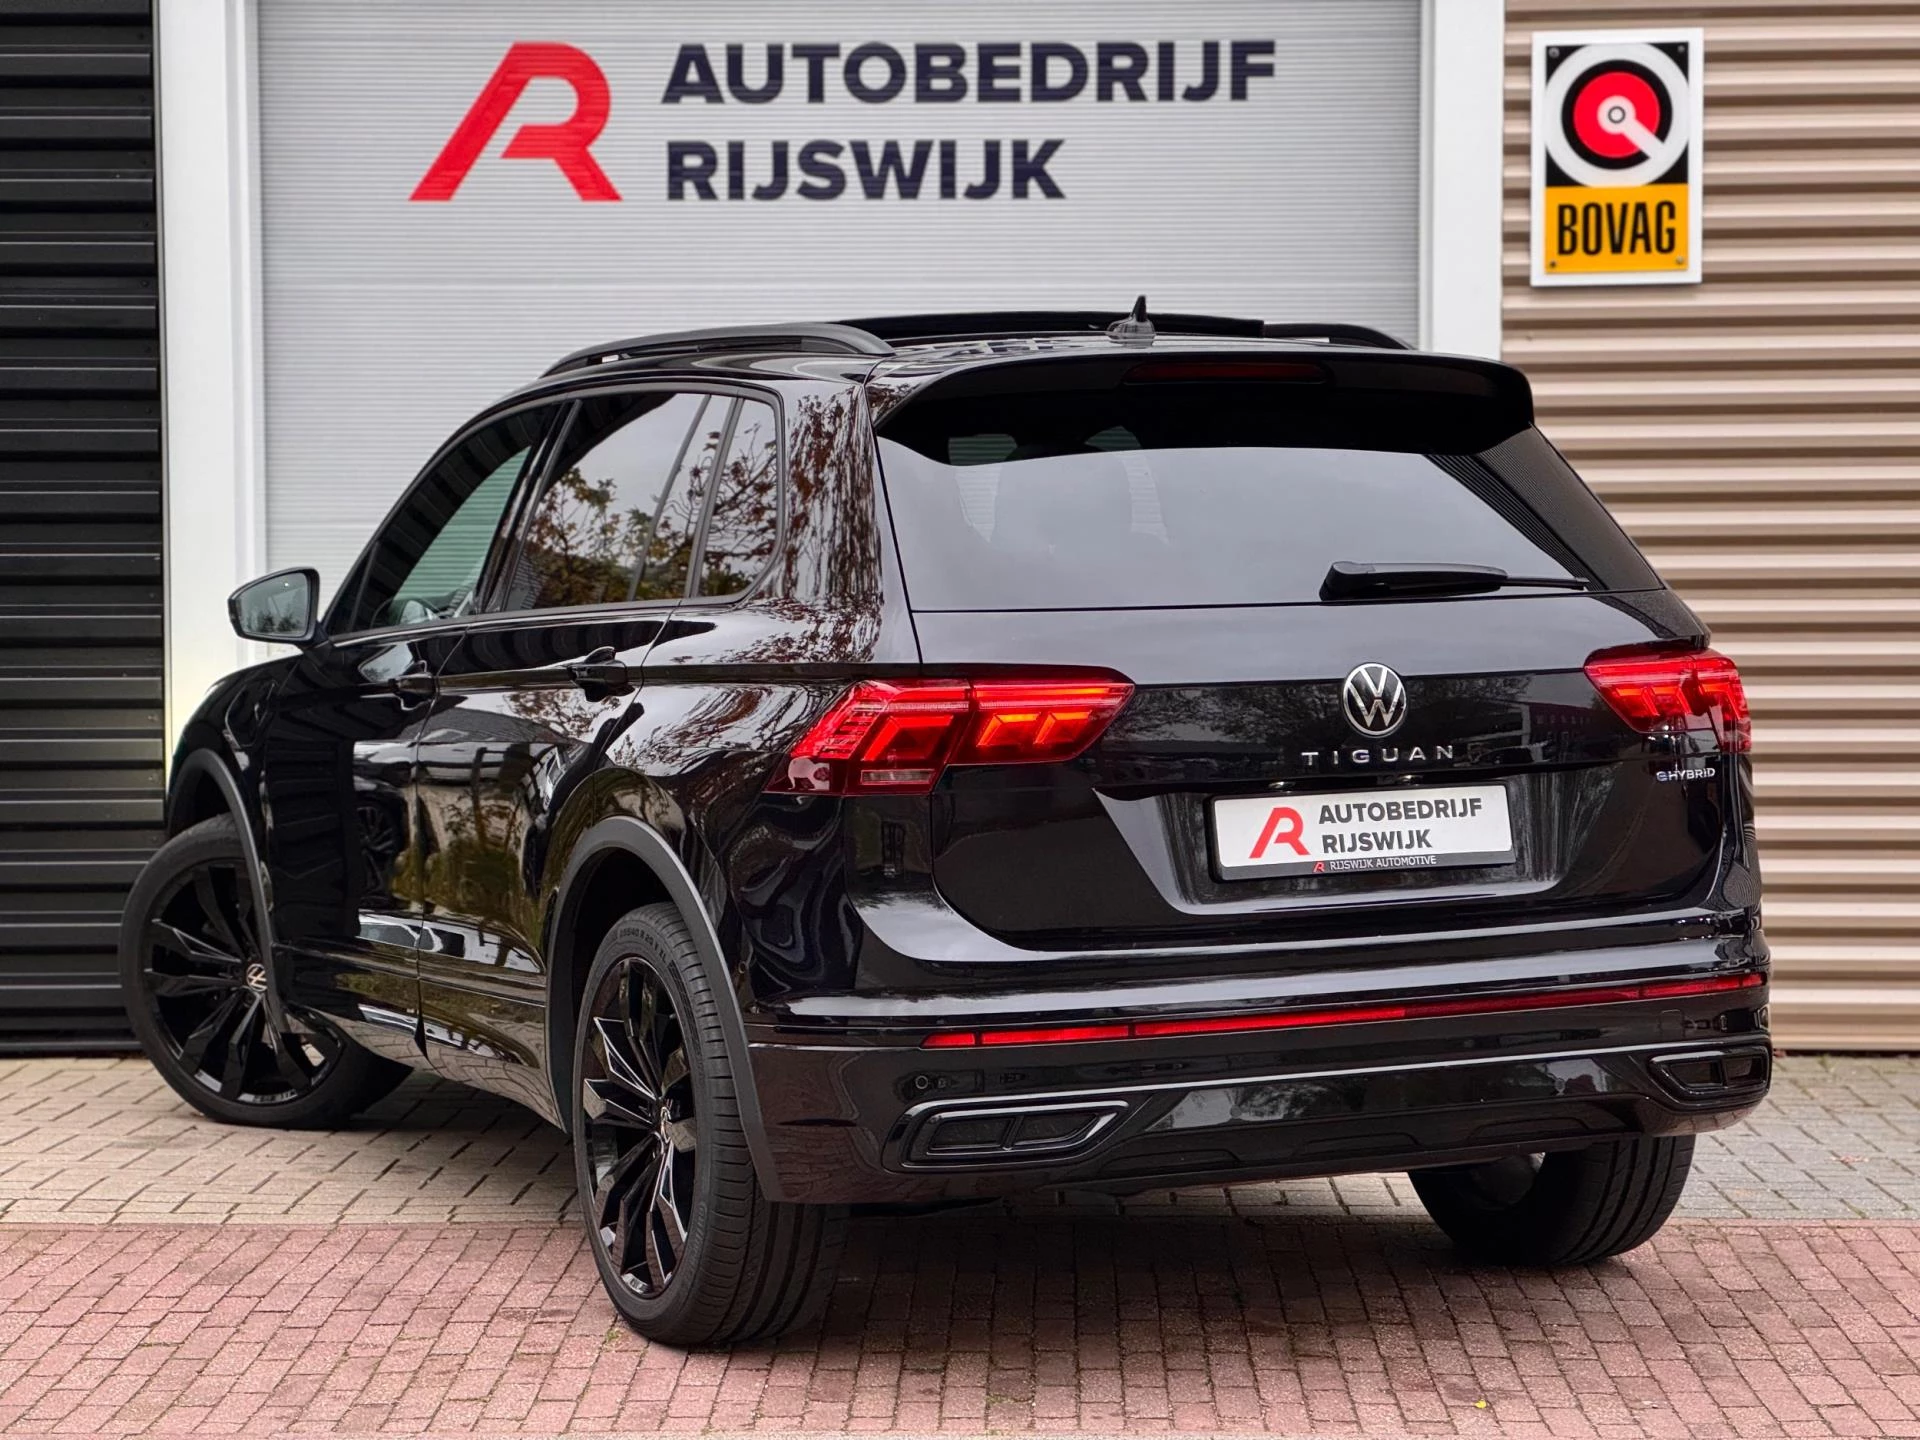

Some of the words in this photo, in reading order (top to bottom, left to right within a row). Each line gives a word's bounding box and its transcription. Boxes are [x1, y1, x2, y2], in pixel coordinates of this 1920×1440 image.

[662, 40, 1276, 104] AUTOBEDRIJF
[667, 139, 1066, 201] RIJSWIJK
[1557, 200, 1676, 256] BOVAG
[1300, 744, 1454, 766] TIGUAN
[1318, 797, 1482, 825] AUTOBEDRIJF
[1322, 828, 1433, 854] RIJSWIJK
[1329, 860, 1374, 871] RIJSWIJK
[1375, 855, 1437, 868] AUTOMOTIVE
